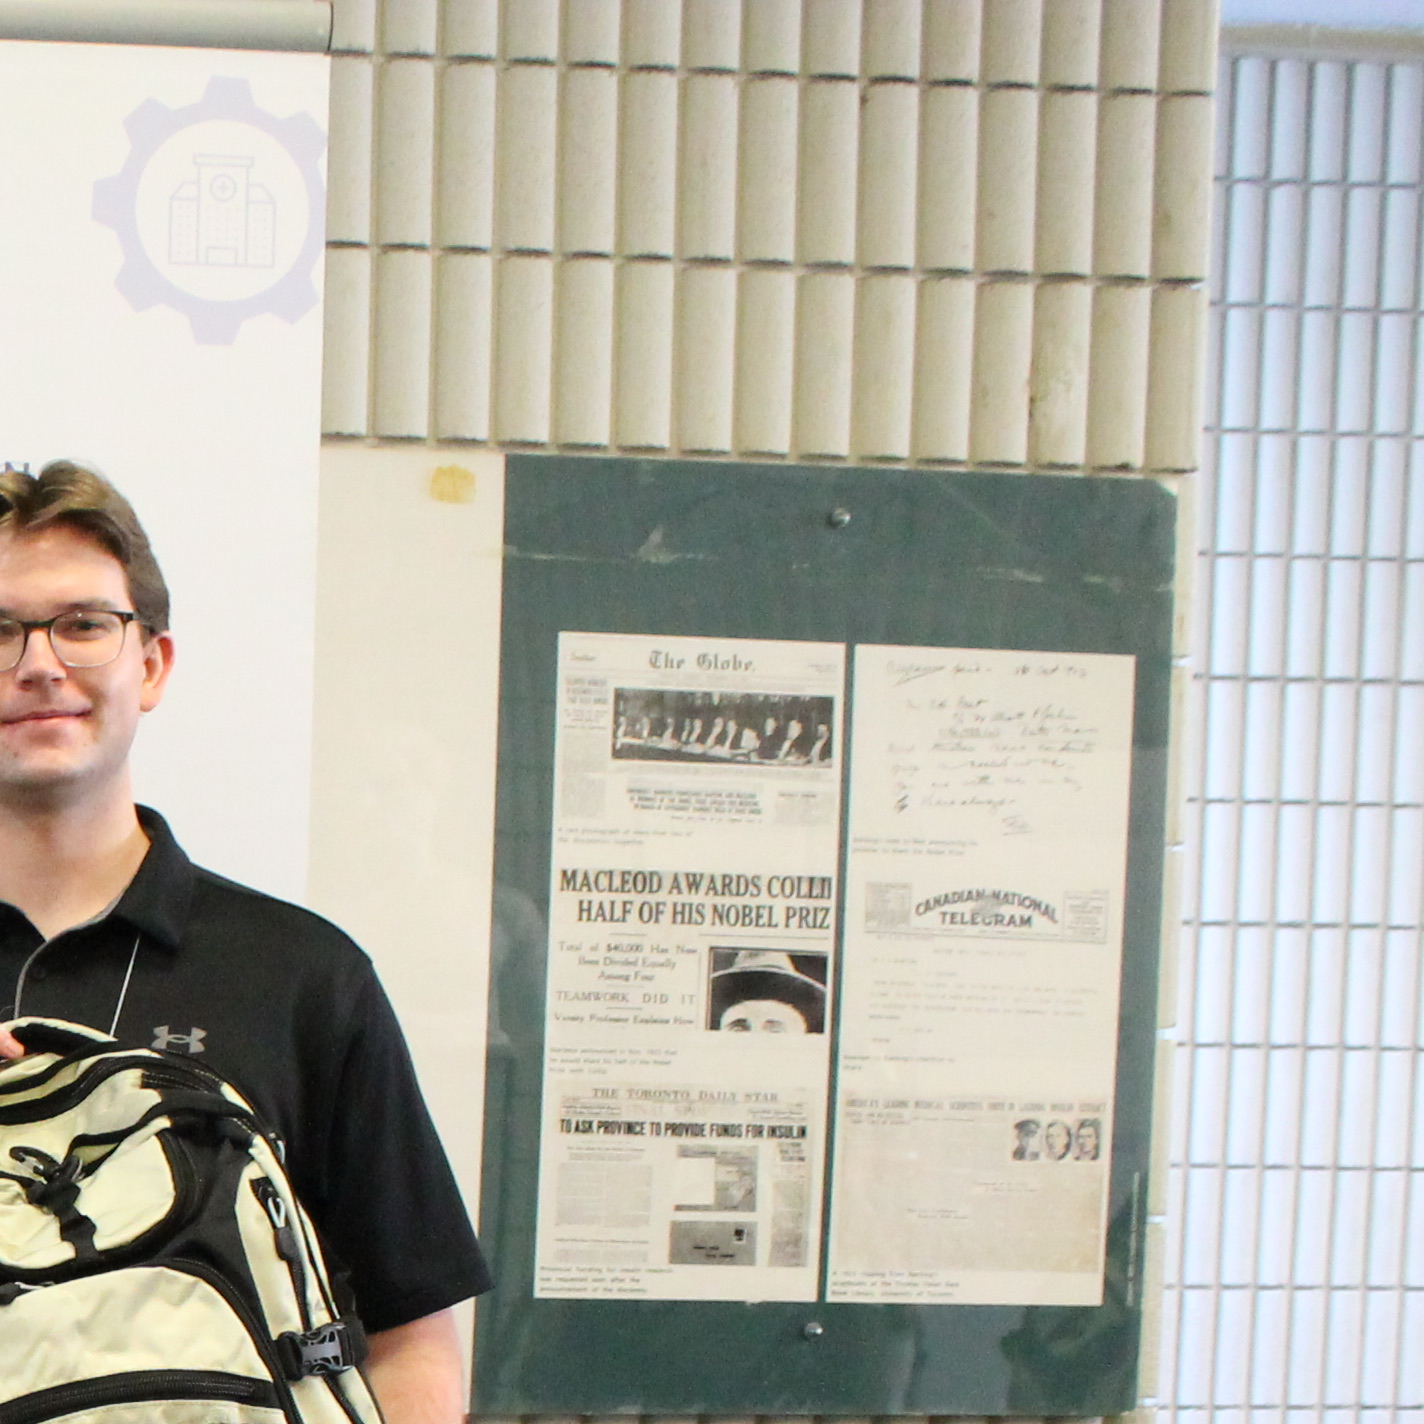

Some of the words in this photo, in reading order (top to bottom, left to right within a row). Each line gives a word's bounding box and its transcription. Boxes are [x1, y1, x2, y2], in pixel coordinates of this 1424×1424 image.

[649, 650, 684, 669] The
[560, 869, 662, 894] MACLEOD
[668, 871, 761, 897] AWARDS
[578, 899, 633, 923] HALF
[639, 901, 666, 923] OF
[672, 902, 705, 925] HIS
[712, 904, 778, 928] NOBEL
[785, 906, 830, 929] PRIZ
[643, 993, 668, 1004] DID
[592, 1088, 618, 1098] THE
[627, 1089, 690, 1101] TORONTO
[699, 1091, 738, 1102] DAILY
[744, 1092, 778, 1102] STAR
[560, 1118, 571, 1132] TO
[574, 1119, 593, 1134] ASK
[597, 1120, 646, 1135] PROVINCE
[650, 1122, 662, 1136] TO
[665, 1122, 706, 1137] PROVIDE
[710, 1123, 742, 1138] FUNDS
[745, 1124, 764, 1138] FOR
[767, 1124, 807, 1139] INSULIN
